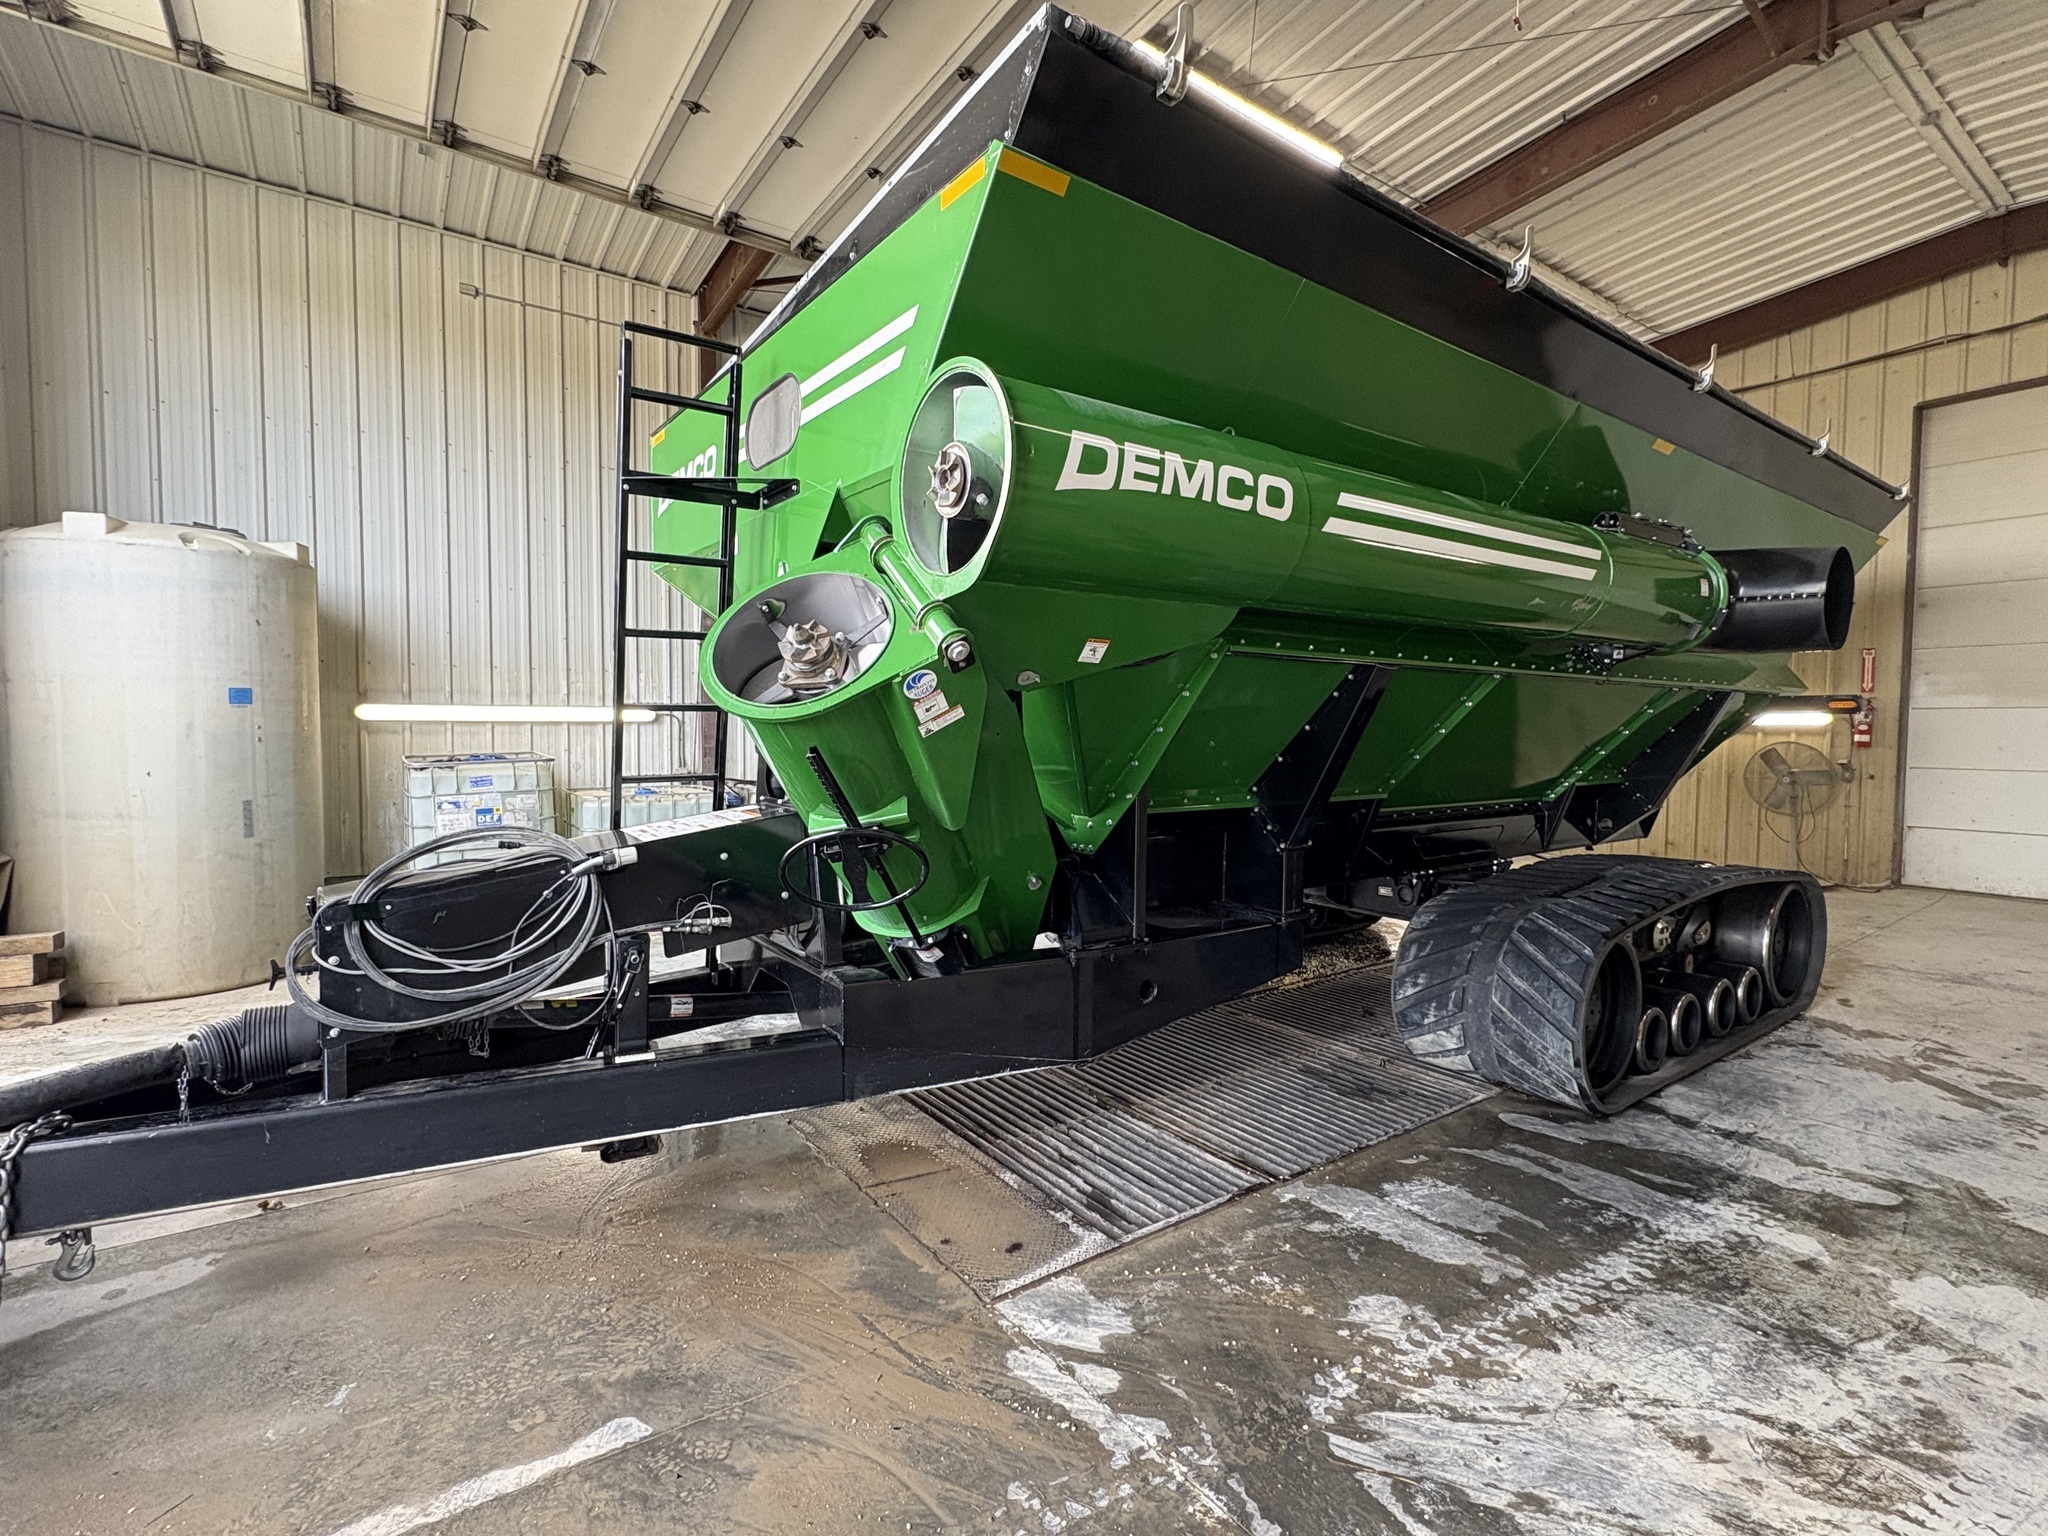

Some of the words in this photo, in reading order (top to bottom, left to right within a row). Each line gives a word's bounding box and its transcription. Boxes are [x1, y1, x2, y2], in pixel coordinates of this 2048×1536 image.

[658, 445, 718, 518] MCO
[1055, 430, 1294, 522] DEMCO
[913, 684, 934, 698] AUGER
[477, 814, 500, 824] DEF
